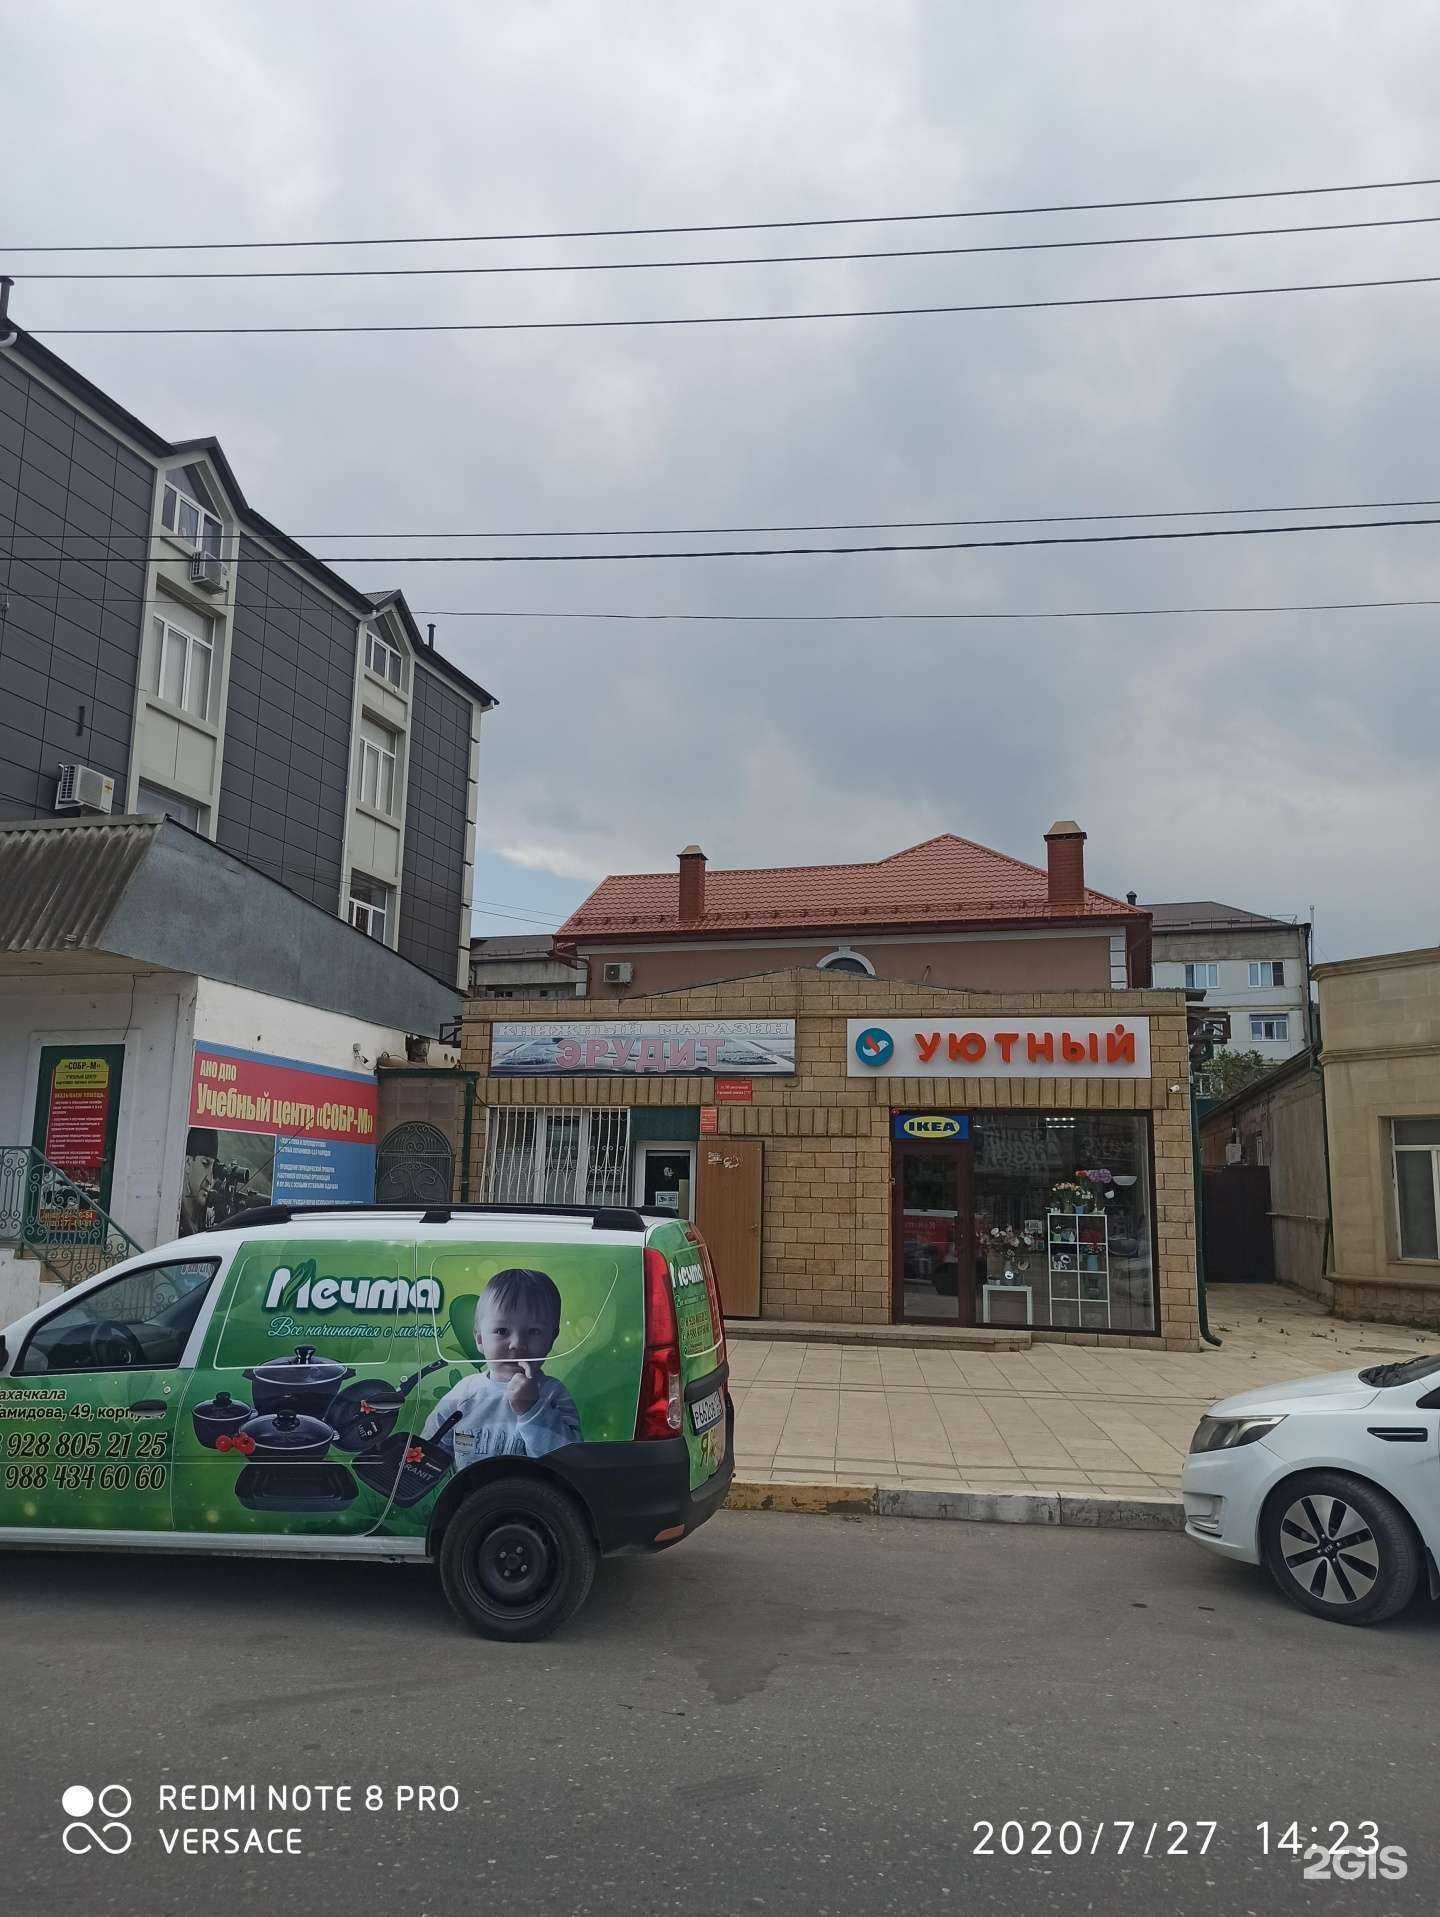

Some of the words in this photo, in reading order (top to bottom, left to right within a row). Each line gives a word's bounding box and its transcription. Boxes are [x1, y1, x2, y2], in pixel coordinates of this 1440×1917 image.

[500, 1021, 642, 1036] КНИЖНЫЙ
[656, 1022, 789, 1036] МАГАЗИН
[914, 1024, 1136, 1064] УЮТНЫЙ
[555, 1038, 725, 1073] ЭРУДИТ
[218, 1063, 237, 1082] ДПО
[197, 1083, 271, 1122] Учебный
[273, 1099, 314, 1131] центр
[317, 1102, 373, 1134] «СОБР-М»
[908, 1121, 956, 1132] IKEA
[265, 1265, 441, 1309] Мечта
[268, 1316, 303, 1337] Все
[305, 1323, 380, 1337] начинается
[0, 1389, 66, 1401] ахачкала
[0, 1404, 67, 1420] амидова,
[7, 1433, 51, 1458] 928
[54, 1433, 101, 1458] 805
[105, 1433, 133, 1458] 21
[135, 1433, 167, 1458] 25
[6, 1465, 48, 1489] 988
[53, 1465, 95, 1489] 434
[100, 1465, 131, 1490] 60
[135, 1465, 166, 1490] 60
[399, 1462, 435, 1481] RANIT
